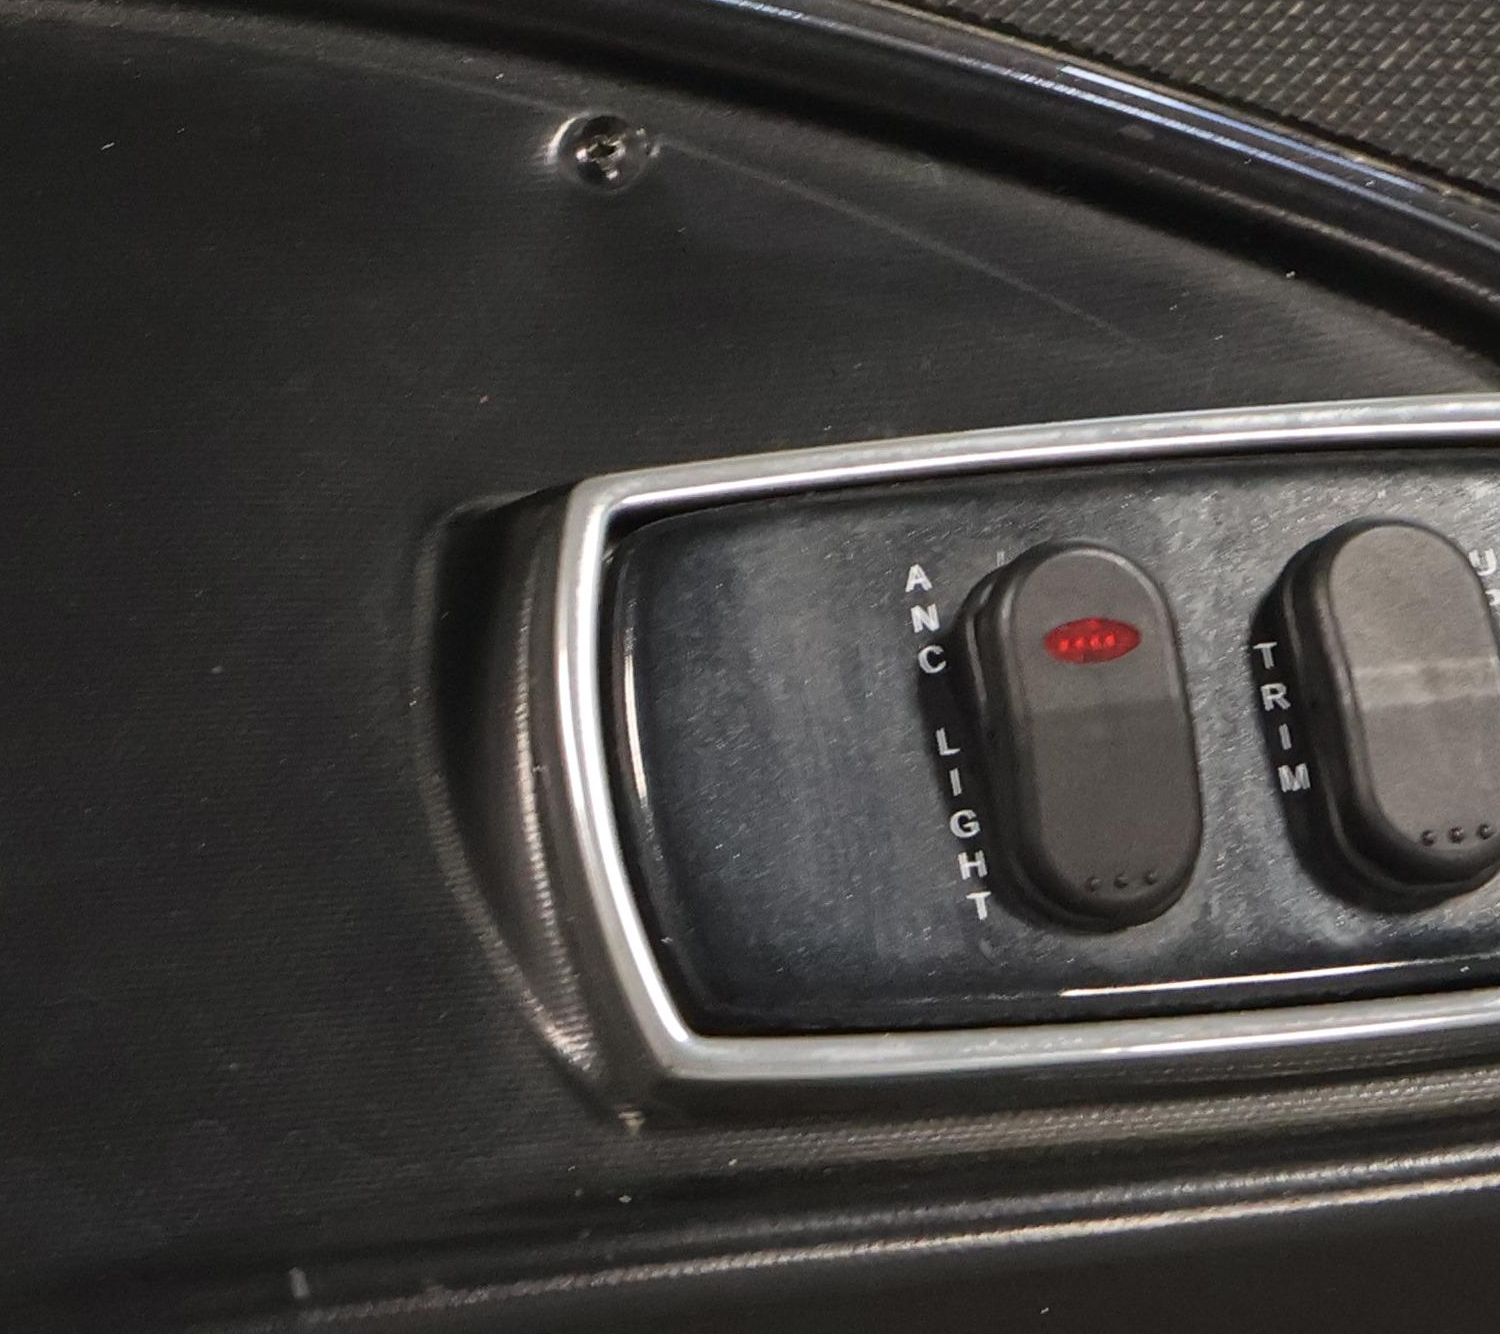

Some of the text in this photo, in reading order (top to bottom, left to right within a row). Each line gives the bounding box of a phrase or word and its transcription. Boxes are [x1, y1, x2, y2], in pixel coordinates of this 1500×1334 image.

[904, 563, 992, 921] ANC LIGHT
[1252, 641, 1312, 793] TRIM
